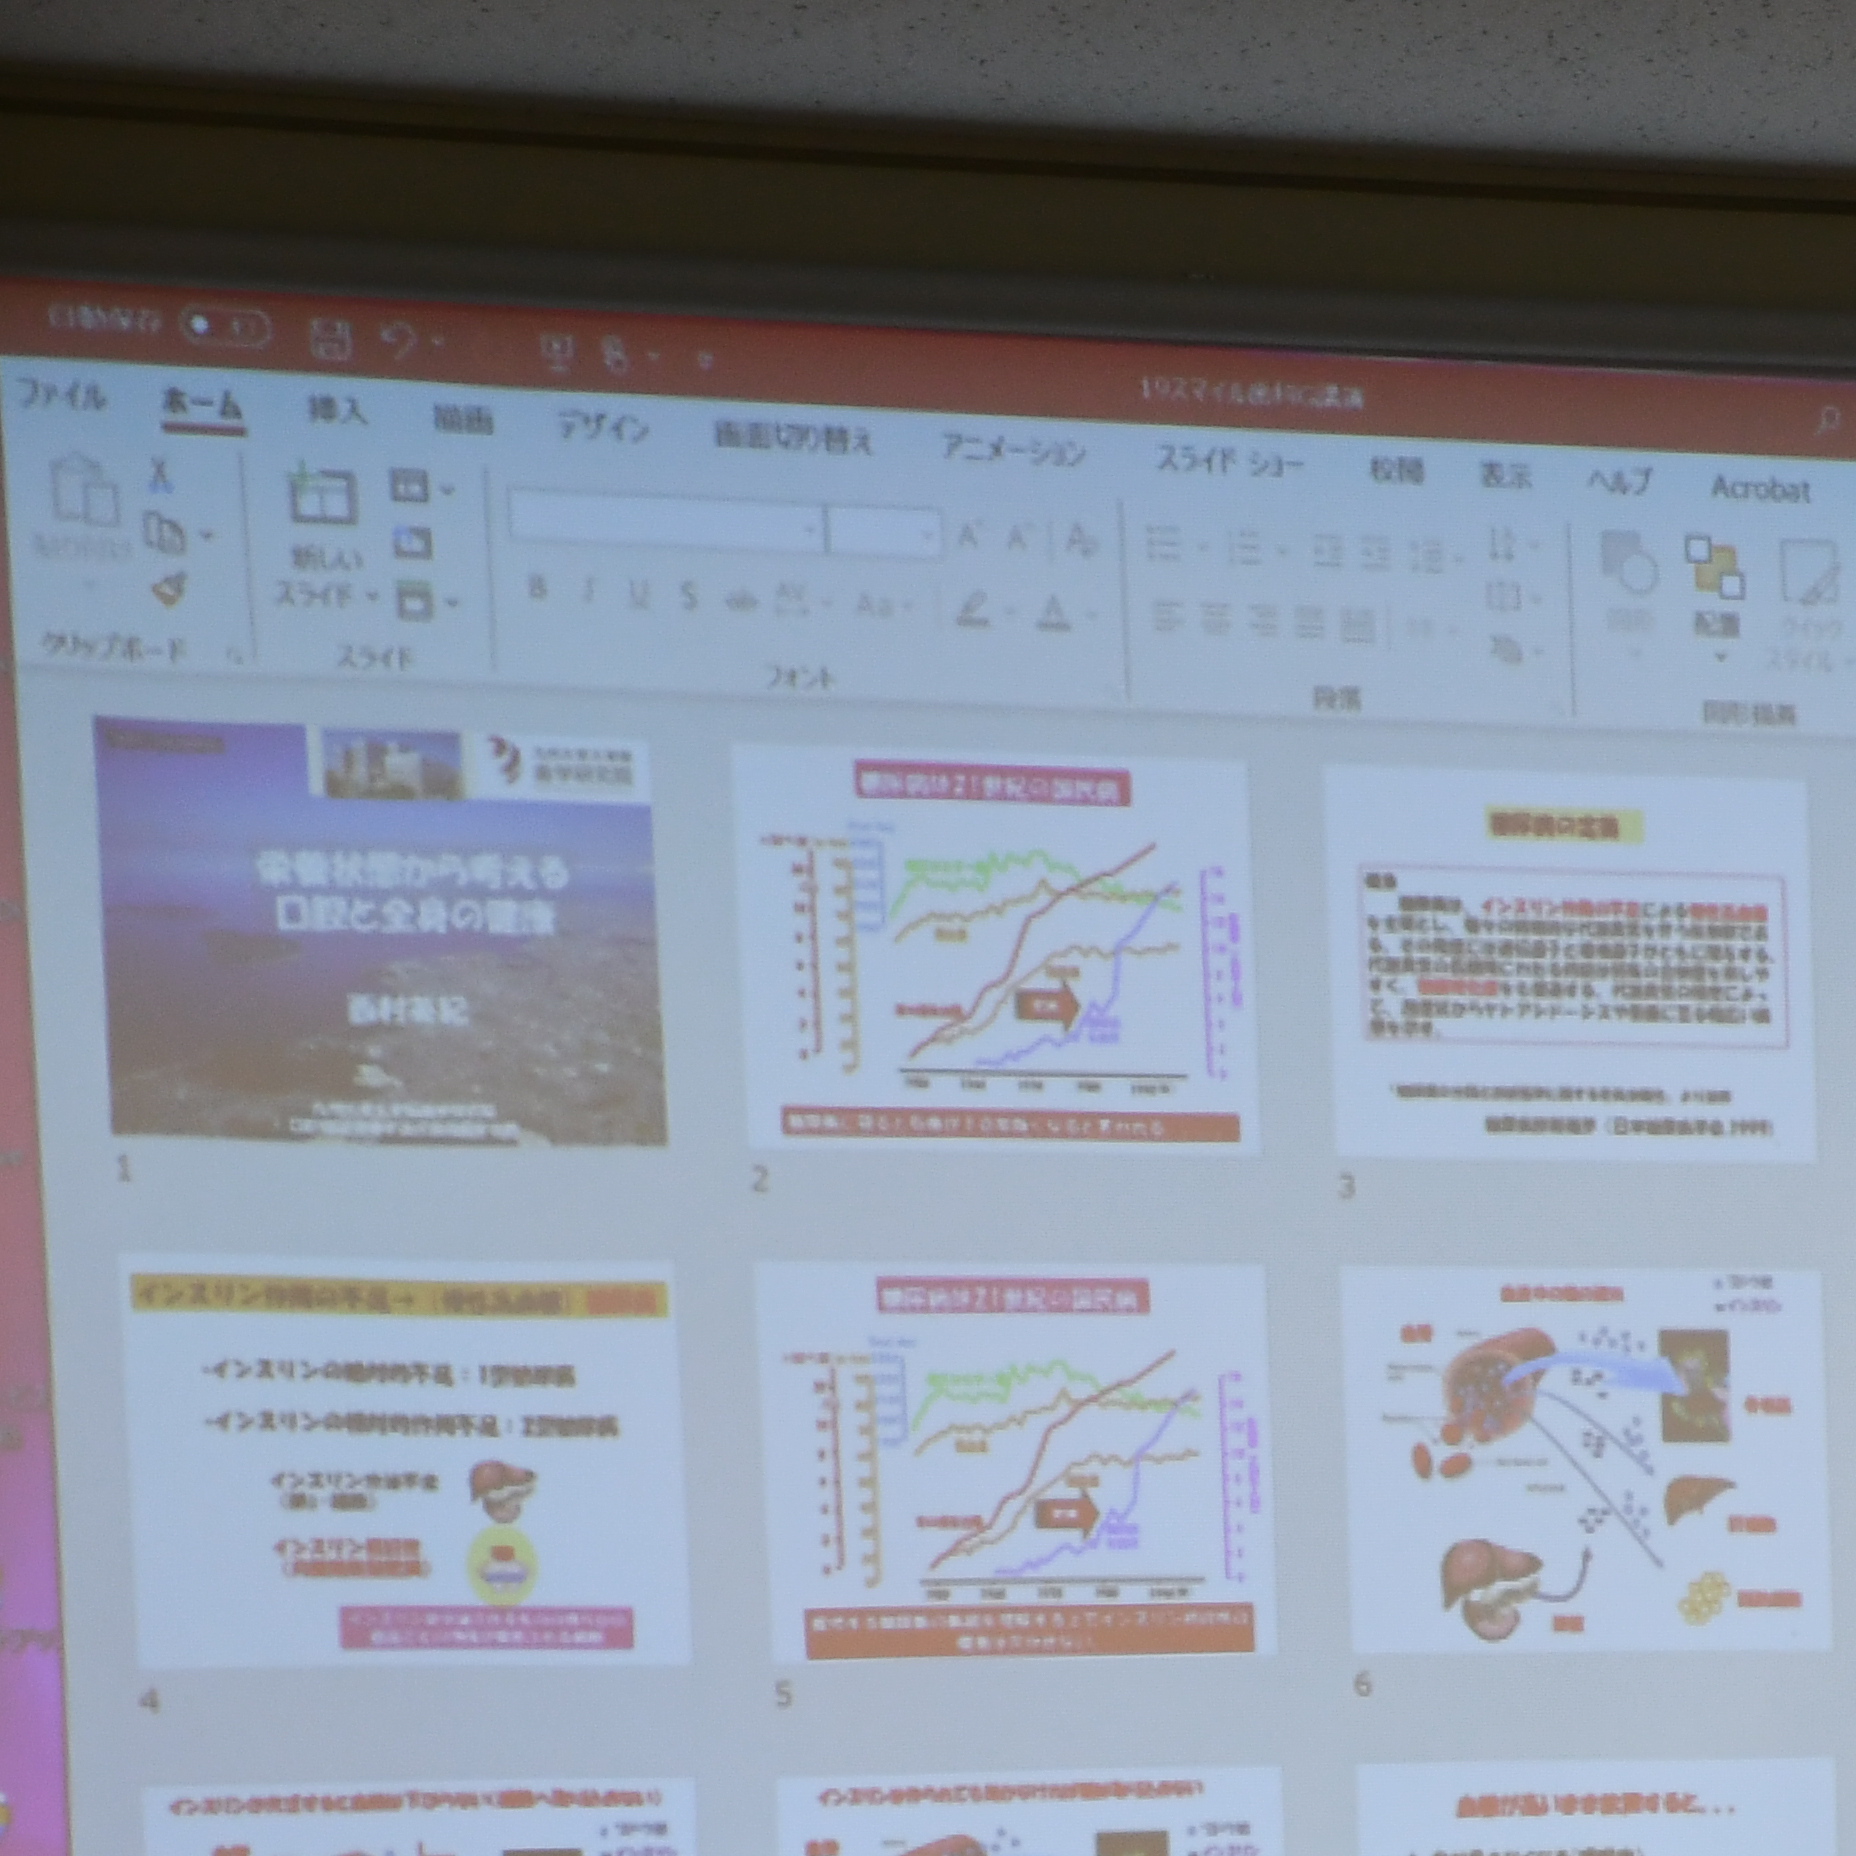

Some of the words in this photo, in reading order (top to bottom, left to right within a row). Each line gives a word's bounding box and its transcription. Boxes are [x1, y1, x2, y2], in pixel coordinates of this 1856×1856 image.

[15, 376, 108, 411] ファイル
[162, 384, 245, 420] ホーム
[943, 431, 1087, 468] アニメーション
[1156, 443, 1237, 475] スライド
[1250, 450, 1305, 478] ショー
[1588, 464, 1655, 496] ヘルプ
[1711, 471, 1812, 505] Acrobat
[752, 1164, 770, 1193] 2
[1340, 1172, 1356, 1200] 3
[775, 1680, 793, 1708] 5
[1354, 1670, 1373, 1698] 6
[140, 1689, 161, 1714] 4
